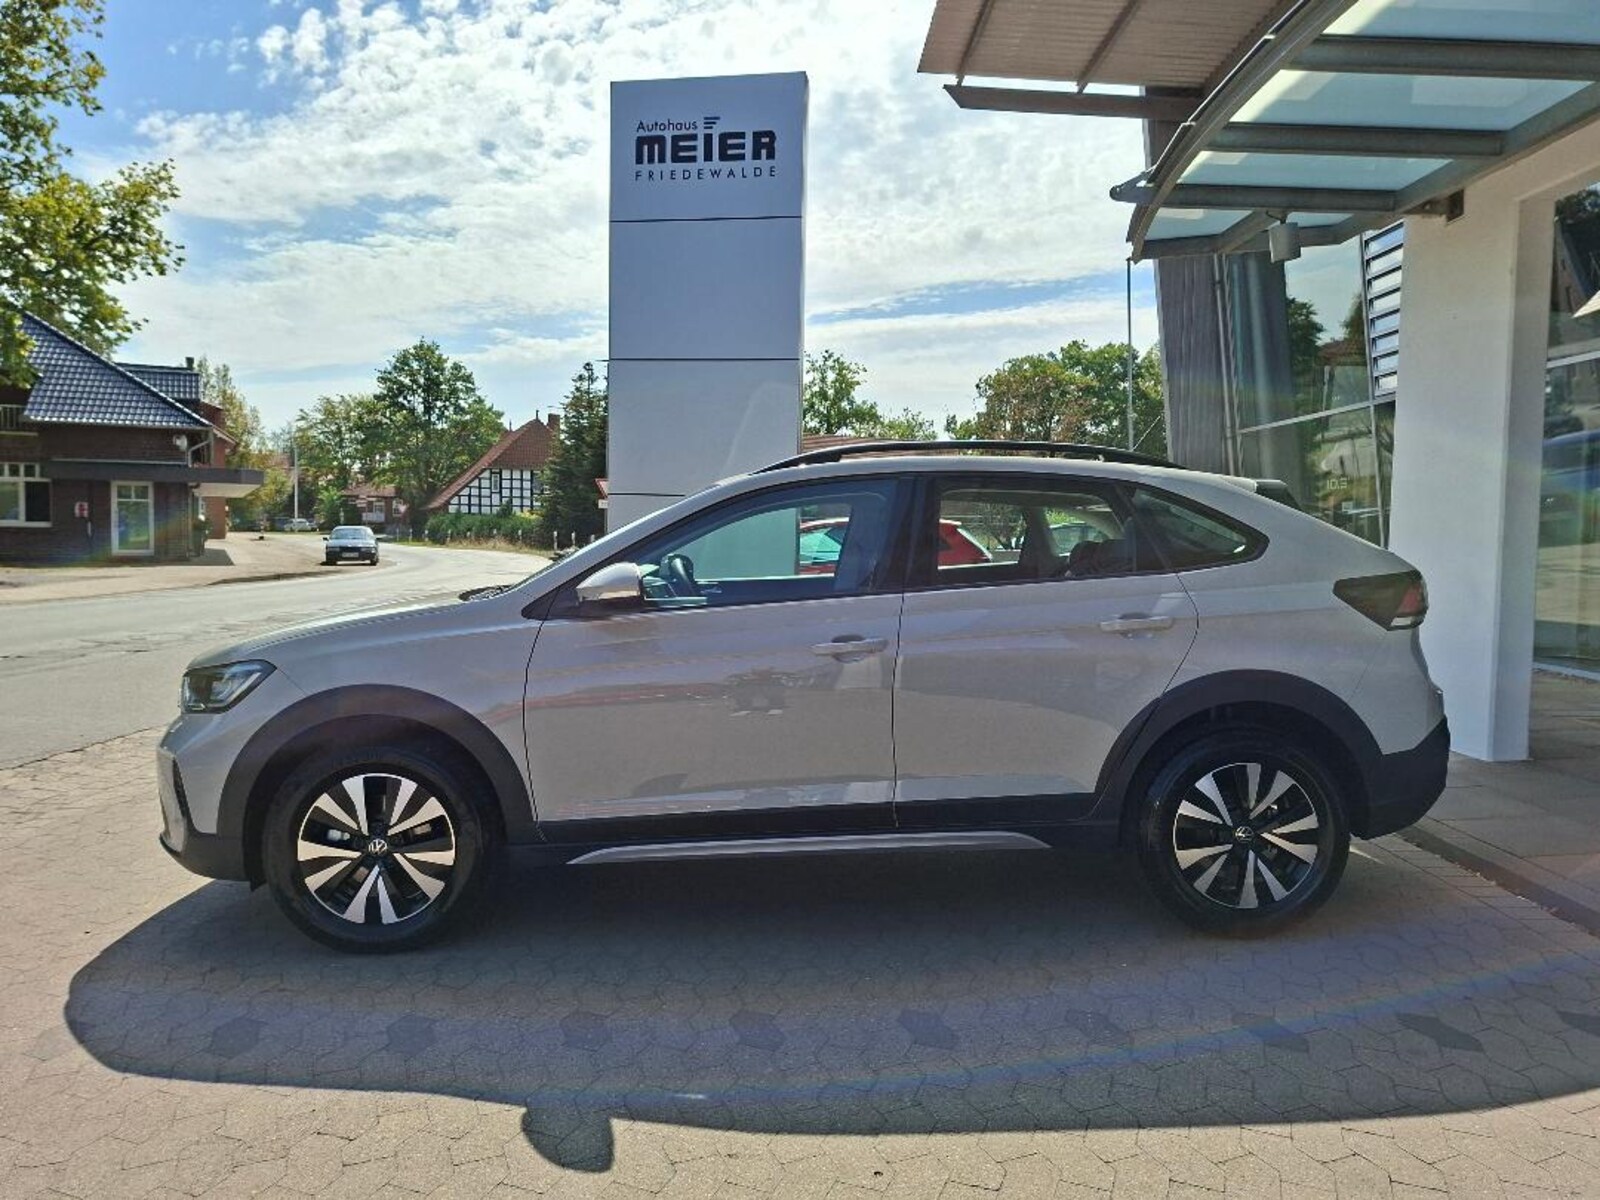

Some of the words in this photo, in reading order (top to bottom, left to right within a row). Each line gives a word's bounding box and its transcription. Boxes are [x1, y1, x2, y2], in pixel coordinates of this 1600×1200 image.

[636, 118, 698, 133] Autohaus
[635, 129, 777, 165] MEIER
[635, 165, 776, 181] FRIEDEWALDE
